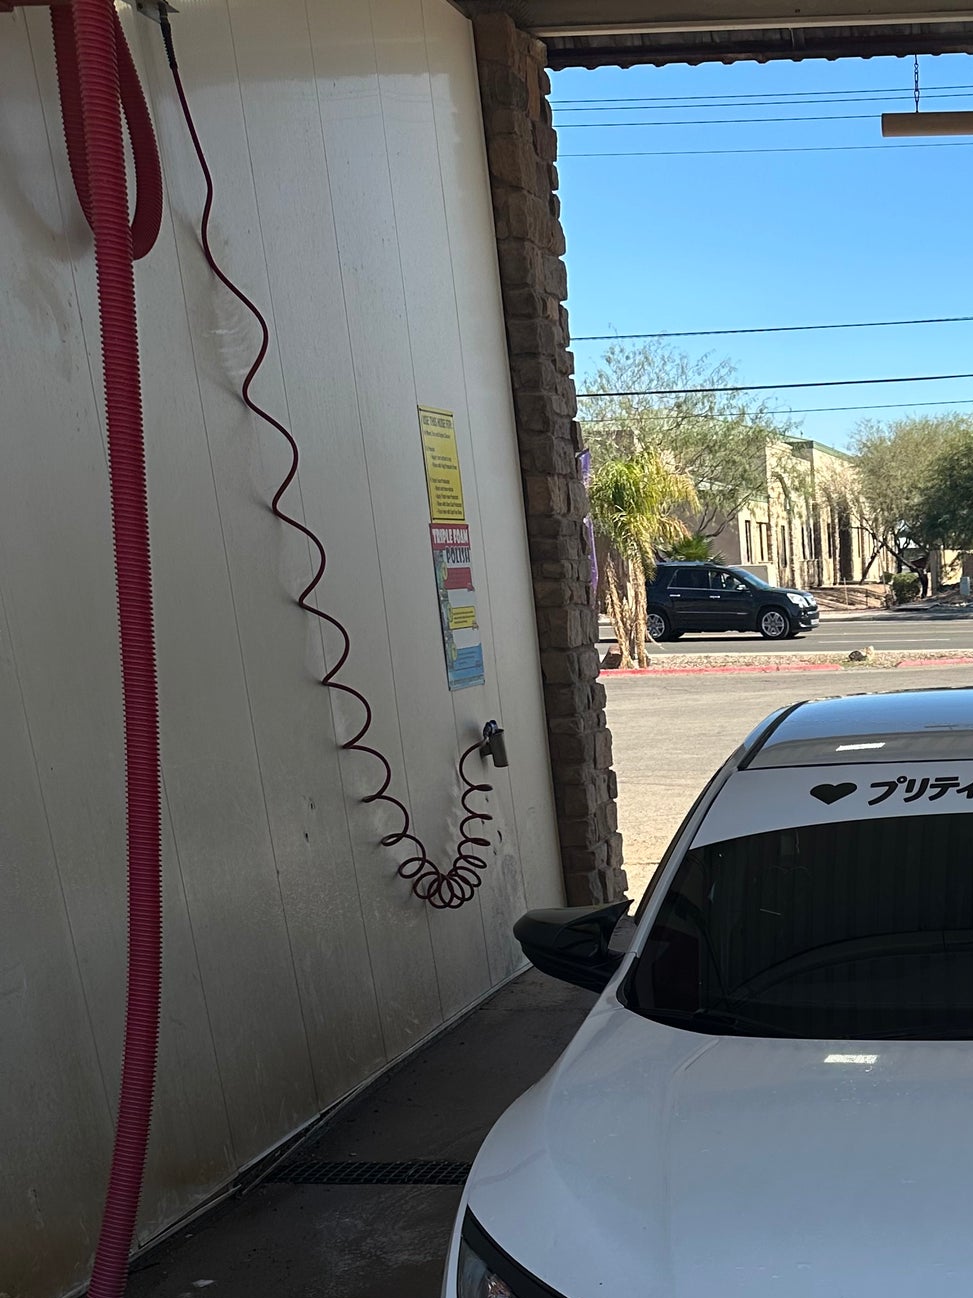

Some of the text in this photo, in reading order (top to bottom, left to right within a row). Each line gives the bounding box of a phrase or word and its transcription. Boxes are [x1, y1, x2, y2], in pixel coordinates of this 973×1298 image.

[432, 528, 469, 544] TRIPLE FOAM
[446, 546, 471, 563] POLISH
